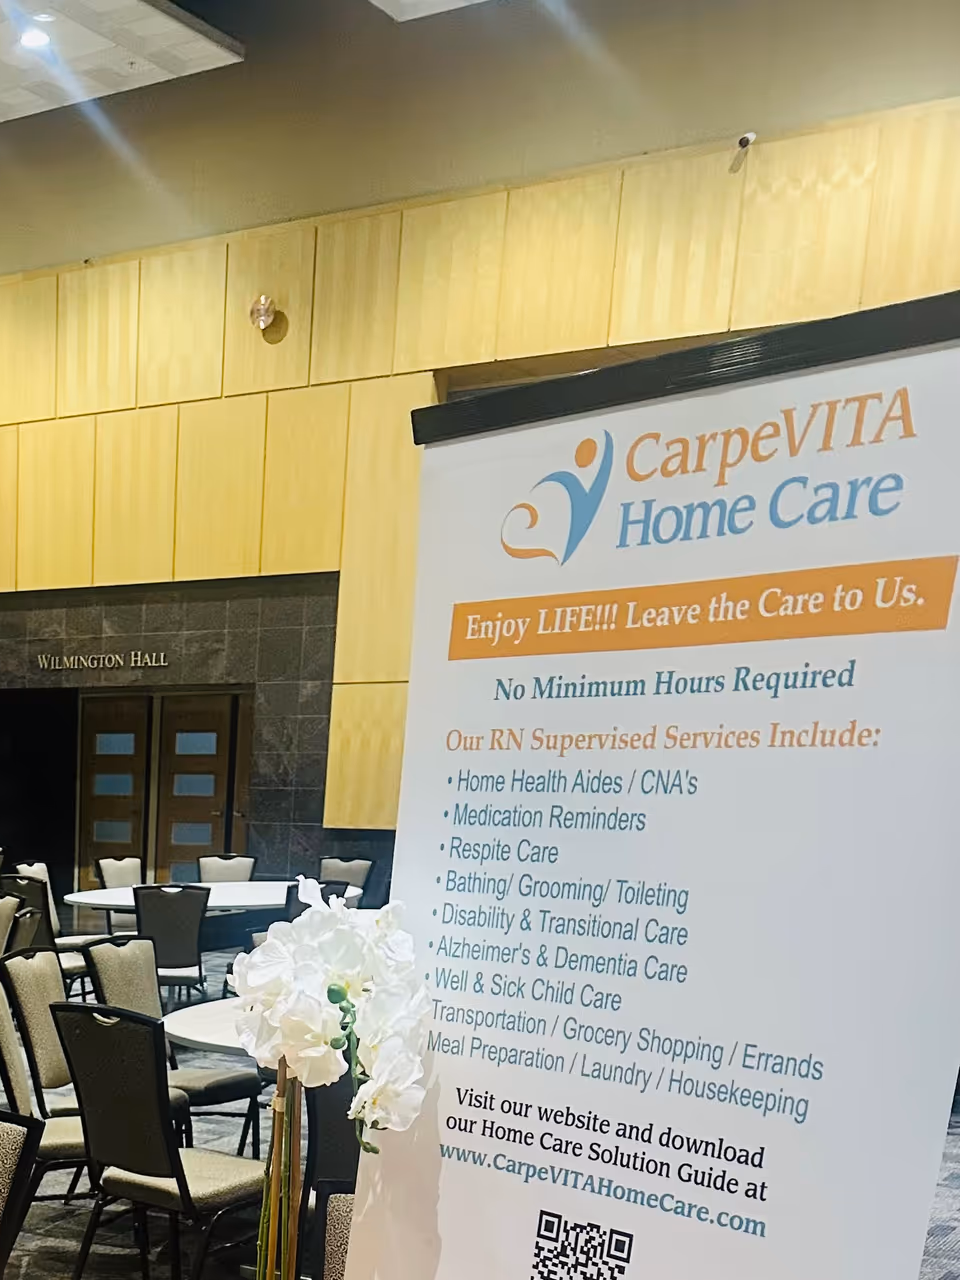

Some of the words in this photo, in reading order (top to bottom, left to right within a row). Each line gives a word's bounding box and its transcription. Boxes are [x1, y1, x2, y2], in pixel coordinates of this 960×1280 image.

[625, 386, 917, 487] CarpeVITA
[616, 494, 755, 548] Home
[769, 472, 904, 530] Care
[466, 613, 530, 645] Enjoy
[537, 604, 617, 634] LIFE!!!
[626, 600, 701, 629] Leave
[708, 592, 749, 622] the
[758, 588, 823, 619] Care
[833, 584, 862, 610] to
[875, 577, 924, 607] Us.
[494, 678, 526, 700] No
[532, 674, 646, 699] Minimum
[655, 669, 725, 695] Hours
[732, 660, 856, 700] Required
[446, 729, 483, 751] Our
[489, 728, 524, 750] RN
[531, 725, 656, 757] Supervised
[663, 726, 760, 750] Services
[768, 720, 881, 749] Include:
[458, 770, 505, 792] Home
[511, 770, 567, 793] Health
[572, 770, 622, 794] Aides
[641, 770, 698, 795] CNA's
[453, 804, 543, 828] Medication
[550, 805, 646, 831] Reminders
[449, 837, 511, 865] Respite
[517, 839, 558, 863] Care
[446, 871, 514, 900] Bathing/
[518, 875, 611, 907] Grooming/
[616, 880, 689, 914] Toileting
[442, 903, 515, 934] Disability
[520, 909, 532, 931] &
[539, 910, 638, 941] Transitional
[644, 921, 688, 946] Care
[437, 935, 530, 965] Alzheimer's
[536, 945, 548, 967] &
[554, 946, 637, 977] Dementia
[644, 955, 687, 983] Care
[435, 967, 468, 992] Well
[473, 972, 485, 994] &
[490, 974, 525, 999] Sick
[532, 978, 573, 1005] Child
[580, 985, 622, 1012] Care
[432, 999, 547, 1037] Transportation
[563, 1017, 632, 1053] Grocery
[637, 1028, 724, 1069] Shopping
[742, 1044, 824, 1080] Errands
[427, 1031, 465, 1056] Meal
[470, 1037, 564, 1073] Preparation
[581, 1055, 652, 1093] Laundry
[669, 1070, 809, 1124] Housekeeping
[456, 1088, 496, 1111] Visit
[500, 1099, 532, 1118] our
[537, 1106, 610, 1134] website
[615, 1121, 653, 1145] and
[658, 1127, 765, 1169] download
[446, 1113, 476, 1134] our
[481, 1121, 534, 1146] Home
[540, 1132, 583, 1157] Care
[588, 1142, 671, 1178] Solution
[677, 1164, 739, 1195] Guide
[744, 1181, 768, 1201] at
[439, 1144, 767, 1238] www.CarpeVITAHomeCare.com
